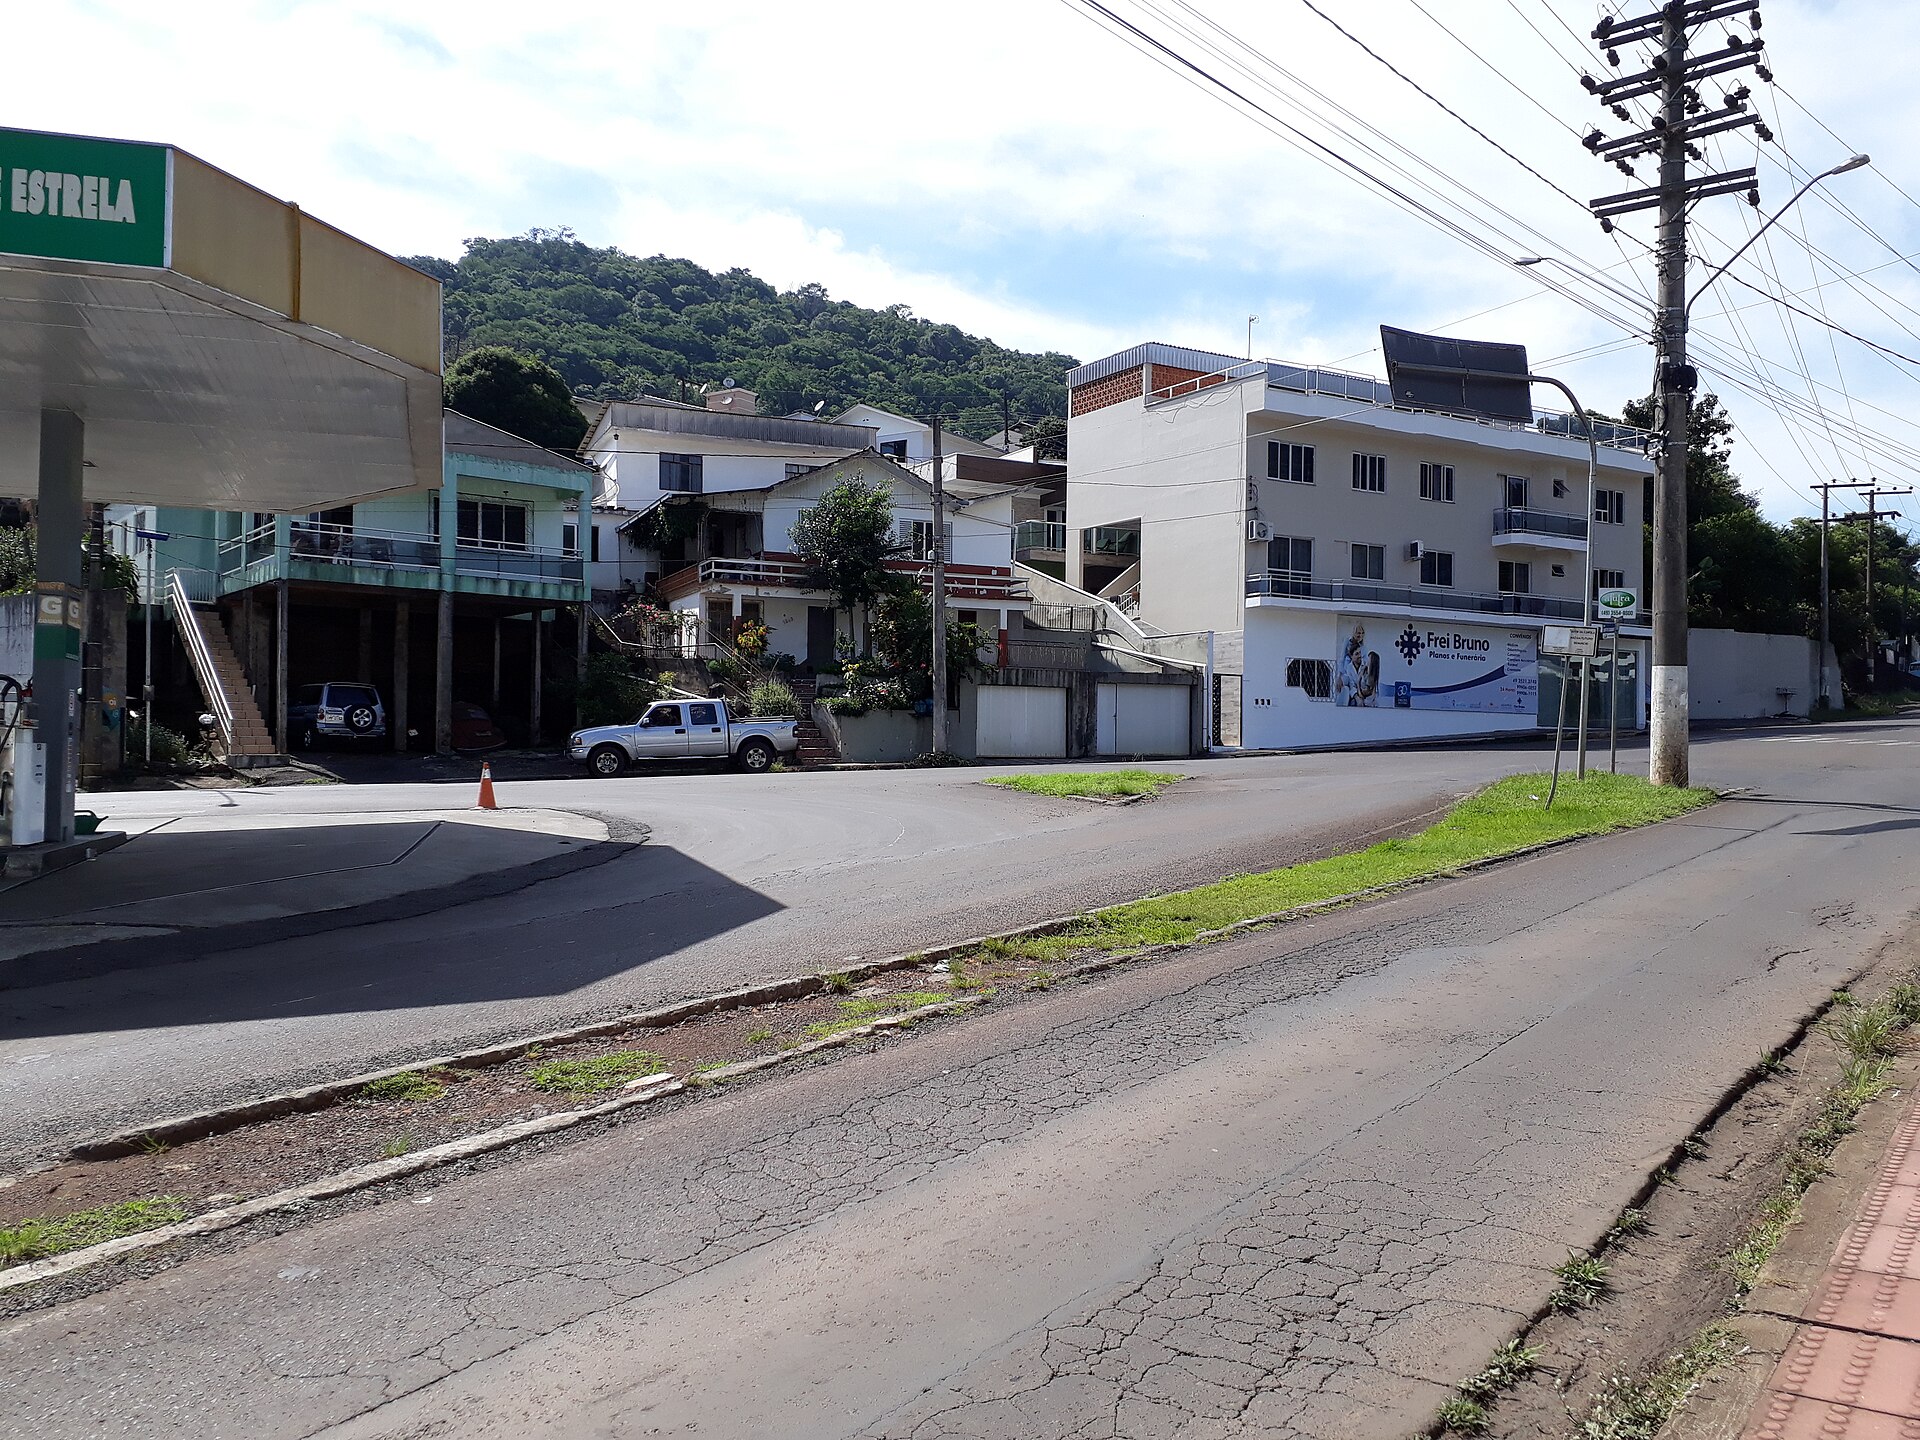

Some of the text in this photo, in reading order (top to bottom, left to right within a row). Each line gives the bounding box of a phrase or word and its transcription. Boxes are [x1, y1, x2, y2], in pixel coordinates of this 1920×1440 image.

[11, 167, 136, 224] ESTRELA
[41, 596, 62, 615] G
[1427, 631, 1490, 651] Frei Bruno
[1429, 651, 1450, 660] Planos
[1456, 653, 1486, 662] Funerária
